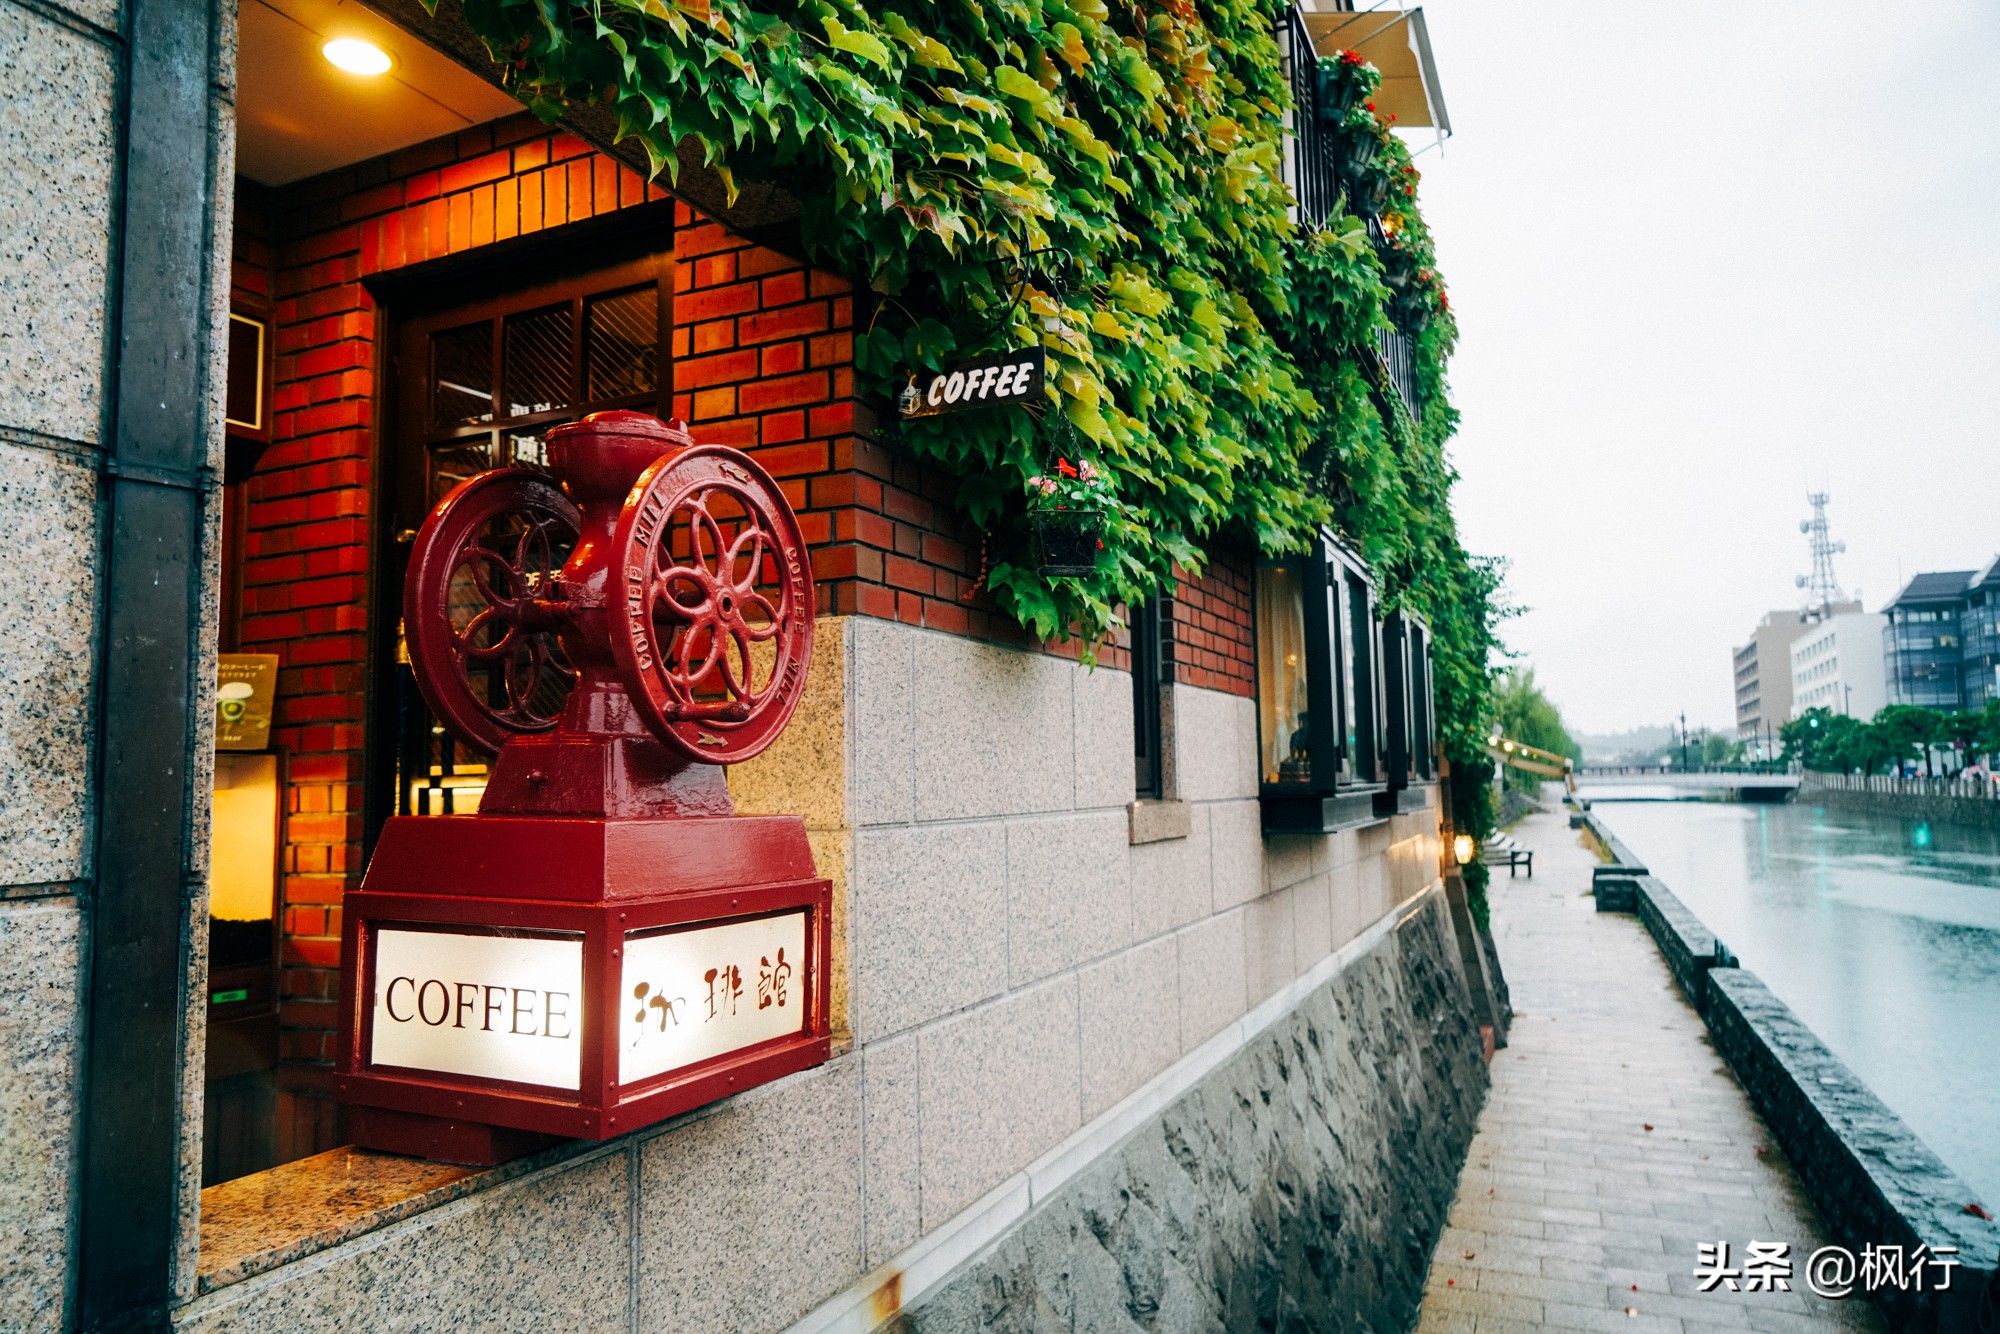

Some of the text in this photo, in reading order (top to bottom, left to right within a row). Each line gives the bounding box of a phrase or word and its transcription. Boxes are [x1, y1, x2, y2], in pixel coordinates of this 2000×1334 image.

[928, 362, 1034, 407] COFFEE
[628, 491, 667, 670] COFFEE MILL
[775, 547, 805, 704] COFFEE MILL
[386, 976, 572, 1039] COFFEE
[629, 947, 792, 1048] 珈琲館
